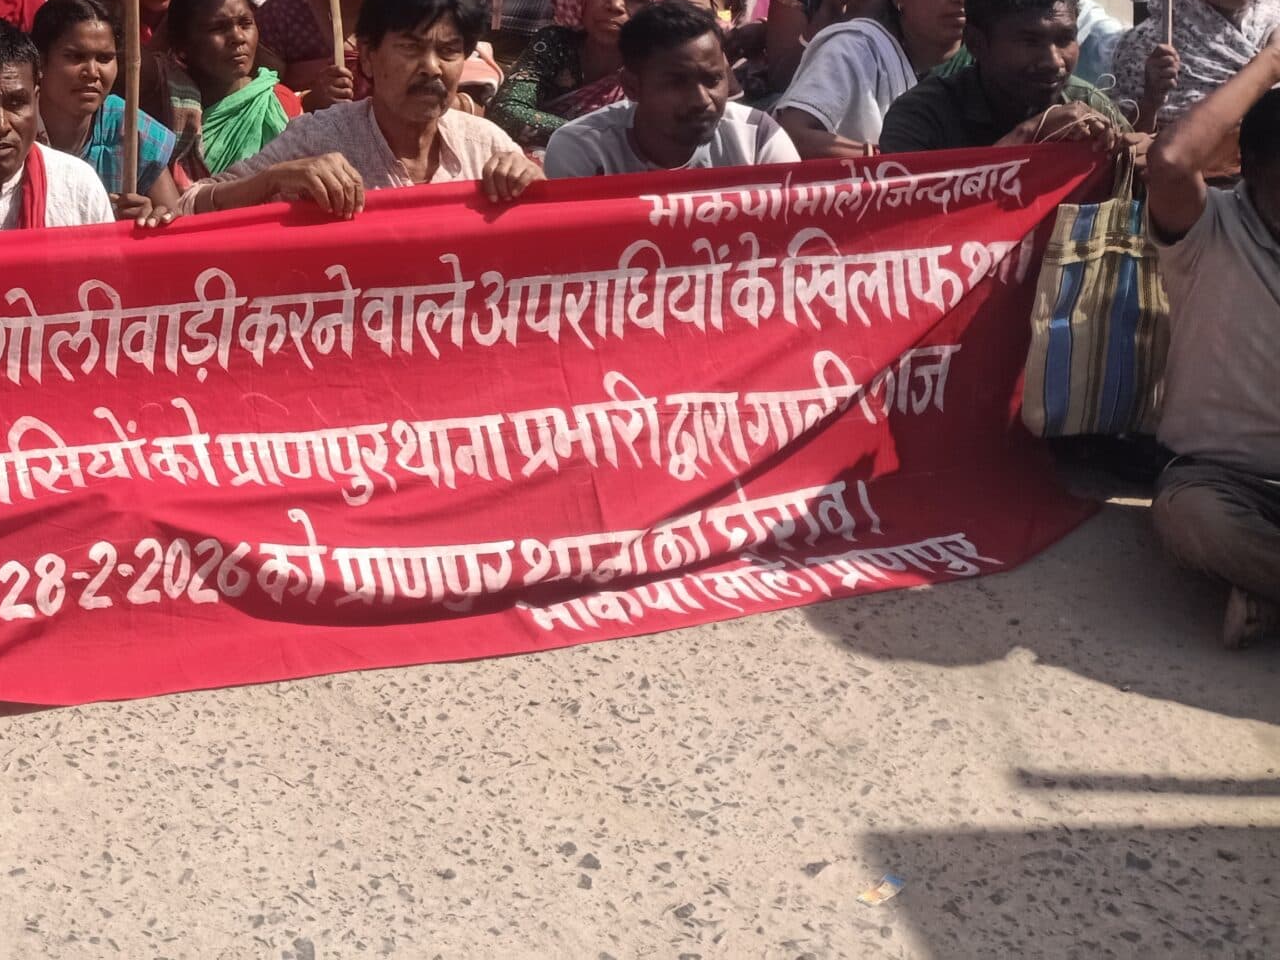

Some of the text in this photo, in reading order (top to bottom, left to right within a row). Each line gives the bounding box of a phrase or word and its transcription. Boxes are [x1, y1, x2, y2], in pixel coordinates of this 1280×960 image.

[239, 265, 361, 371] करने
[362, 253, 475, 360] वाले
[471, 238, 732, 349] अपराधियों
[730, 232, 777, 329] के
[780, 227, 963, 328] खिलाफ
[150, 397, 220, 486] को
[216, 423, 397, 506] प्राणपुर
[391, 414, 512, 490] थाना
[508, 371, 661, 479] प्रभारी
[665, 392, 750, 481] द्वारा
[256, 508, 327, 605] को
[332, 540, 515, 611] प्राणपुर
